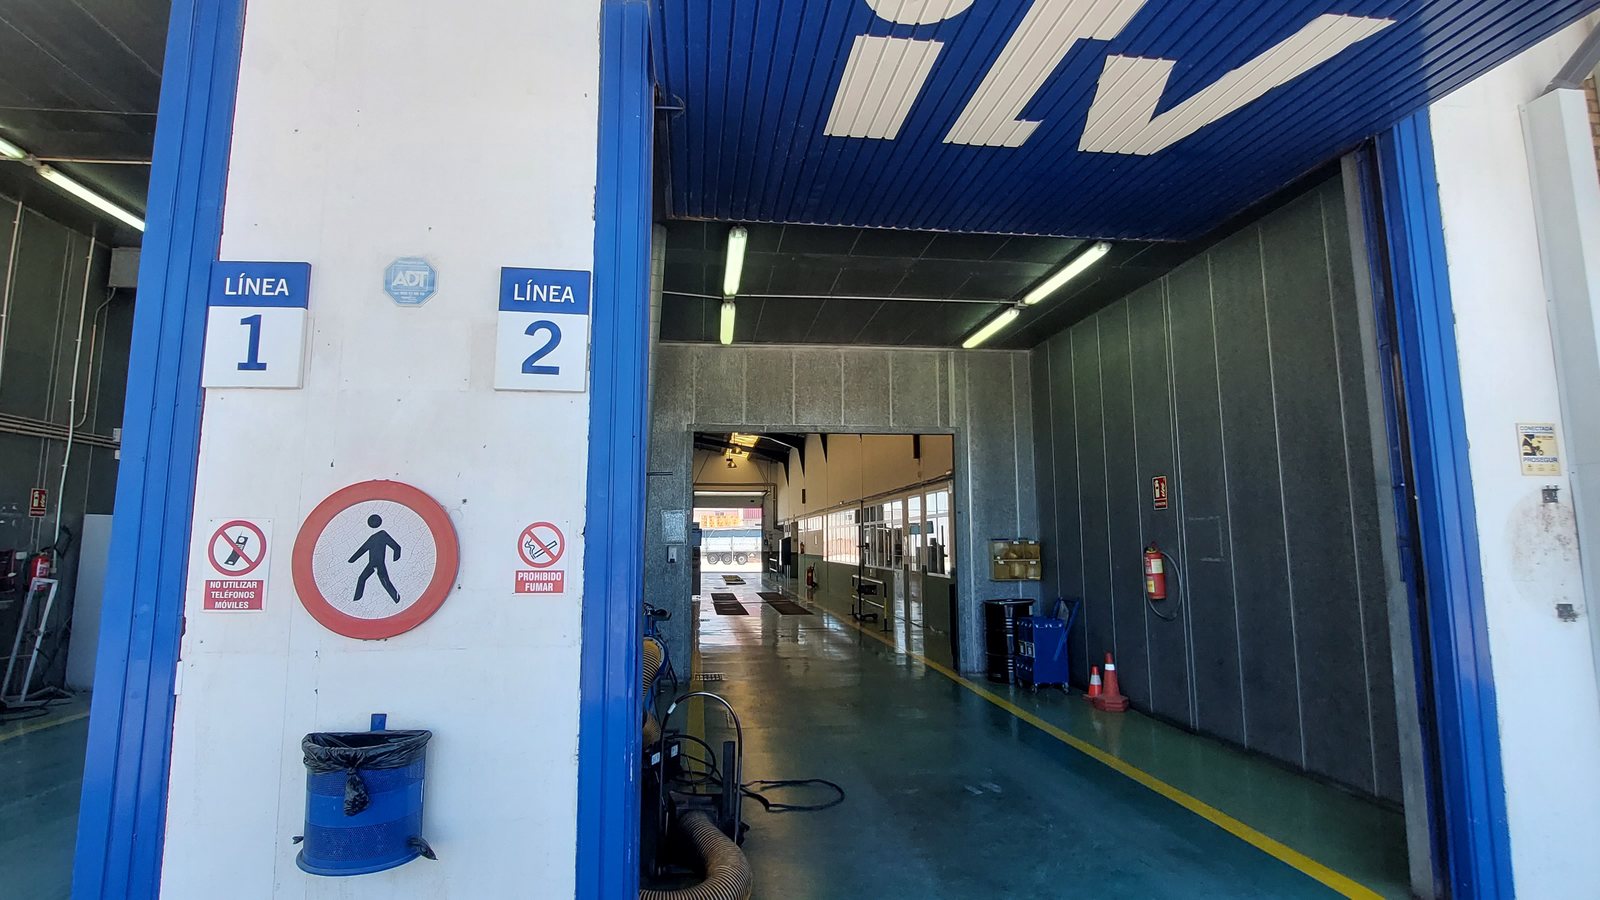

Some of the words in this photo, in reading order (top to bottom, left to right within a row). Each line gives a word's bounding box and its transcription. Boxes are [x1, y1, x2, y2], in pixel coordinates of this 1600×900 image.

[225, 273, 289, 296] LÍNEA
[392, 270, 429, 288] ADT
[513, 279, 575, 304] LÍNEA
[237, 314, 267, 371] 1
[521, 320, 562, 376] 2
[518, 572, 562, 581] PROHIBIDO
[210, 581, 221, 589] NO
[223, 581, 257, 589] UTILIZAR
[524, 582, 554, 592] FUMAR
[211, 590, 255, 599] TELÉFONOS
[214, 600, 249, 609] MÓVILES
